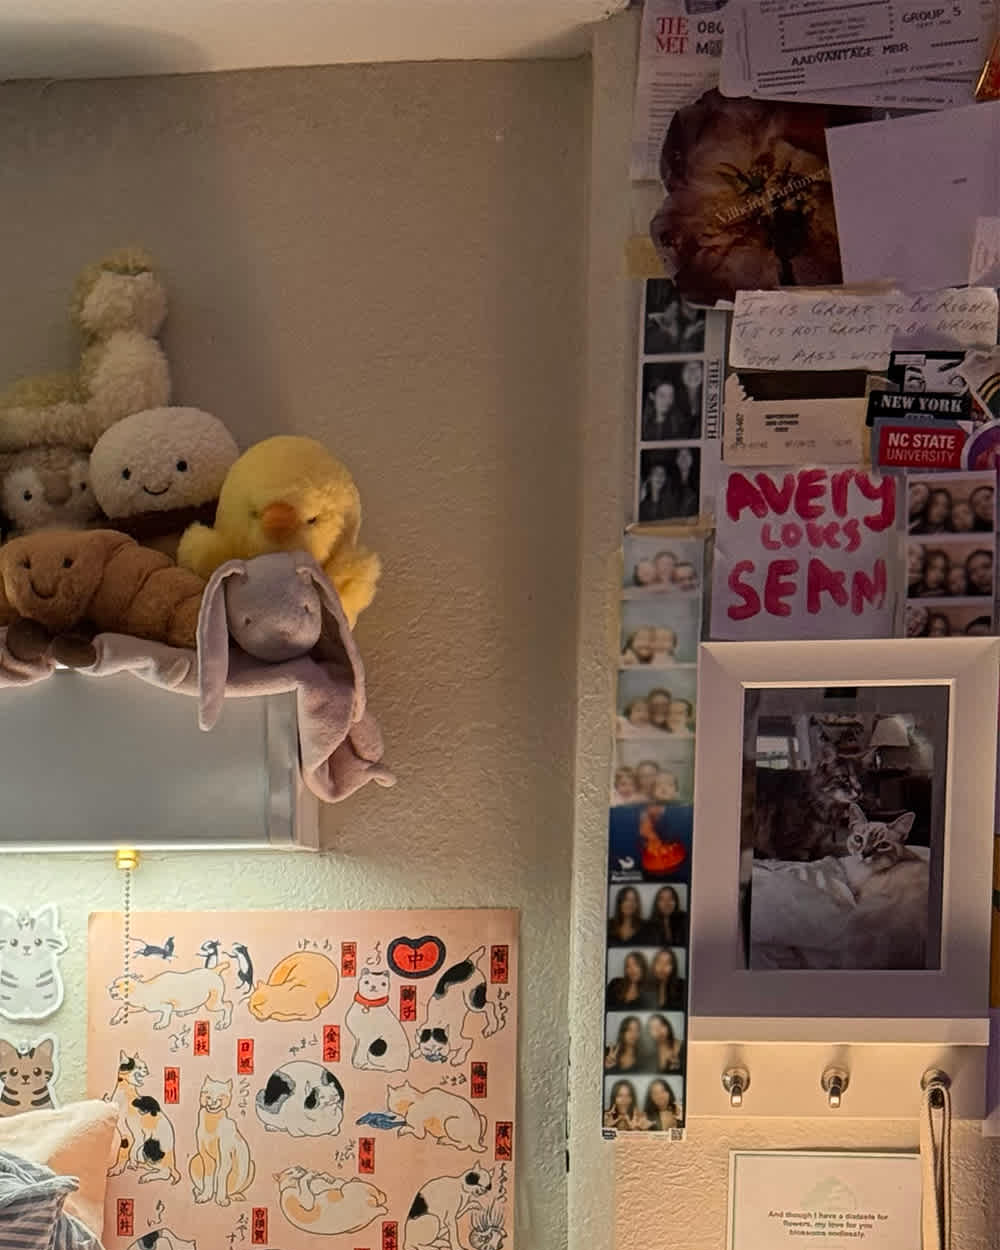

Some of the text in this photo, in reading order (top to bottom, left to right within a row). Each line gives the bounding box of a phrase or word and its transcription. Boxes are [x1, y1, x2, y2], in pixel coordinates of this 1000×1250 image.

[902, 8, 945, 24] GROUP
[952, 6, 962, 17] 5
[655, 16, 689, 35] THE
[655, 36, 689, 55] MET
[791, 45, 873, 67] AADVANTAGE
[880, 394, 963, 413] NEW YORK
[707, 393, 720, 440] SMITH
[888, 432, 956, 450] NC STATE
[887, 447, 955, 464] UNIVERSITY
[725, 469, 897, 532] AVERY
[727, 558, 887, 621] SEAN
